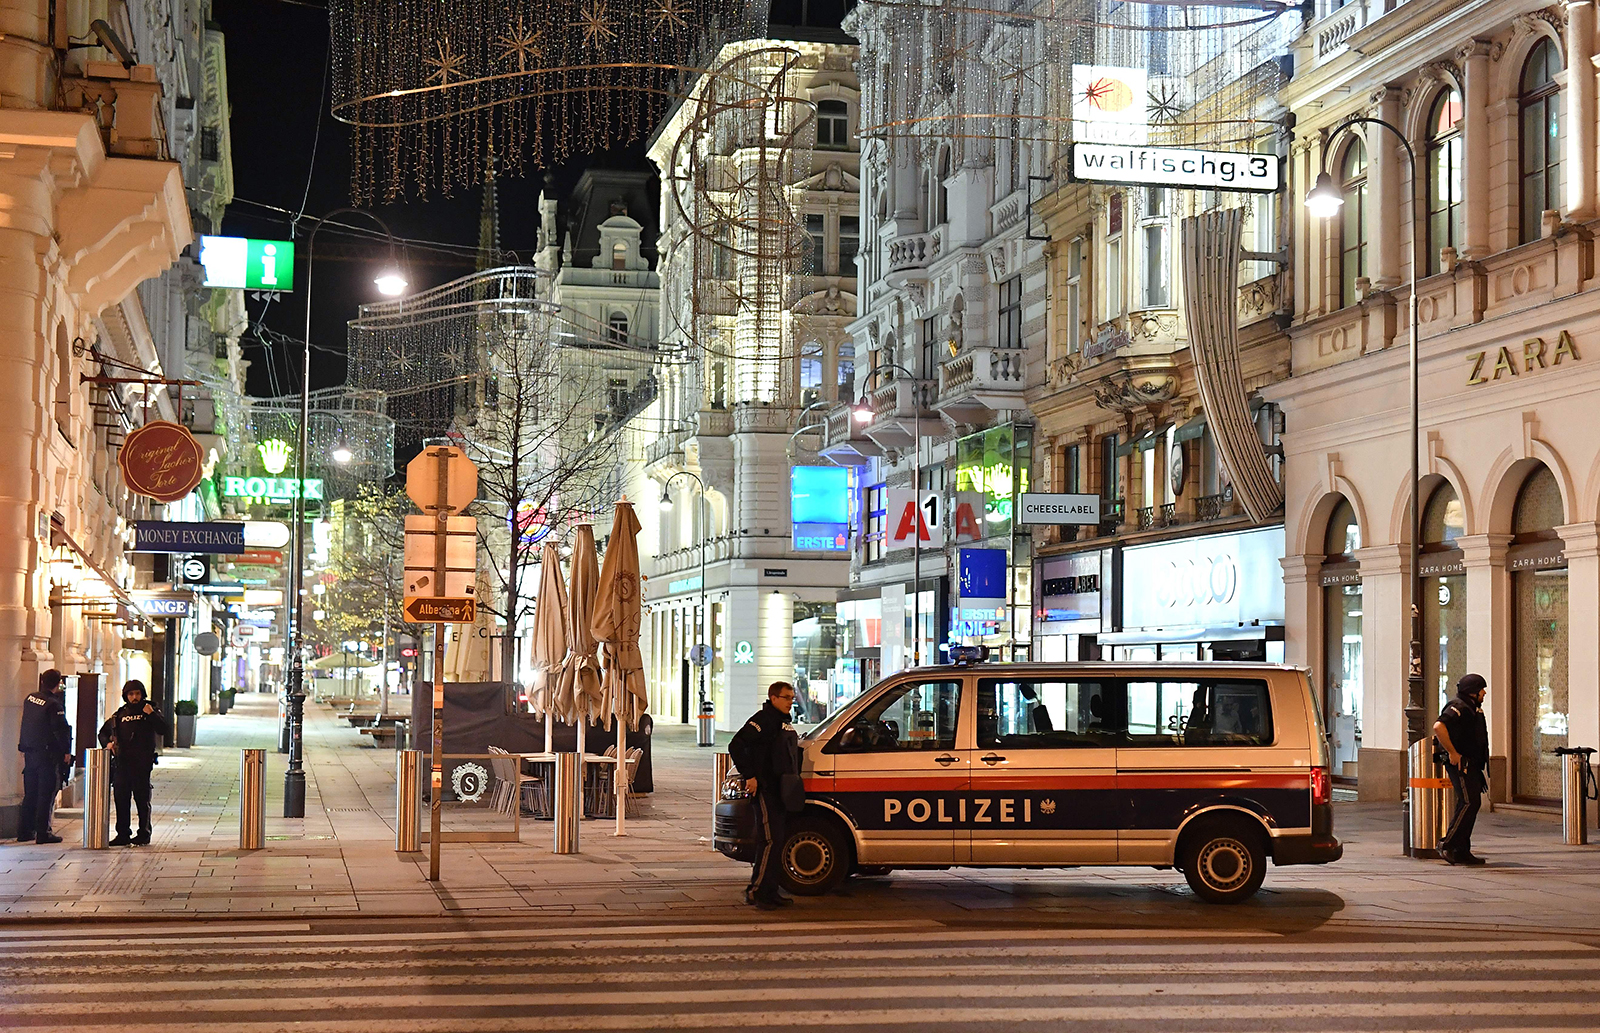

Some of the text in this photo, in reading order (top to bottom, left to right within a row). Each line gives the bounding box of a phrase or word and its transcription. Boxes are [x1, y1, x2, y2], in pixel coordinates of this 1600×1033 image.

[1083, 151, 1268, 182] walfischg.3
[261, 243, 278, 285] i
[1466, 330, 1581, 386] ZARA
[128, 436, 184, 463] Original
[147, 469, 177, 491] Torte
[224, 476, 323, 499] ROLEX
[1026, 505, 1095, 514] CHEESELABEL
[894, 495, 938, 541] A1
[138, 529, 179, 544] MONEY
[182, 530, 243, 545] EXCHANGE
[796, 537, 835, 549] ERSTE
[1420, 563, 1463, 575] ZARA HOME
[1512, 556, 1562, 568] ZARA HOME
[1323, 574, 1360, 584] ZARA HOME
[145, 600, 187, 614] ANGE
[961, 608, 996, 620] ERSTE
[27, 694, 47, 707] POLIZEI
[464, 776, 475, 792] S
[884, 798, 1031, 823] POLIZEI
